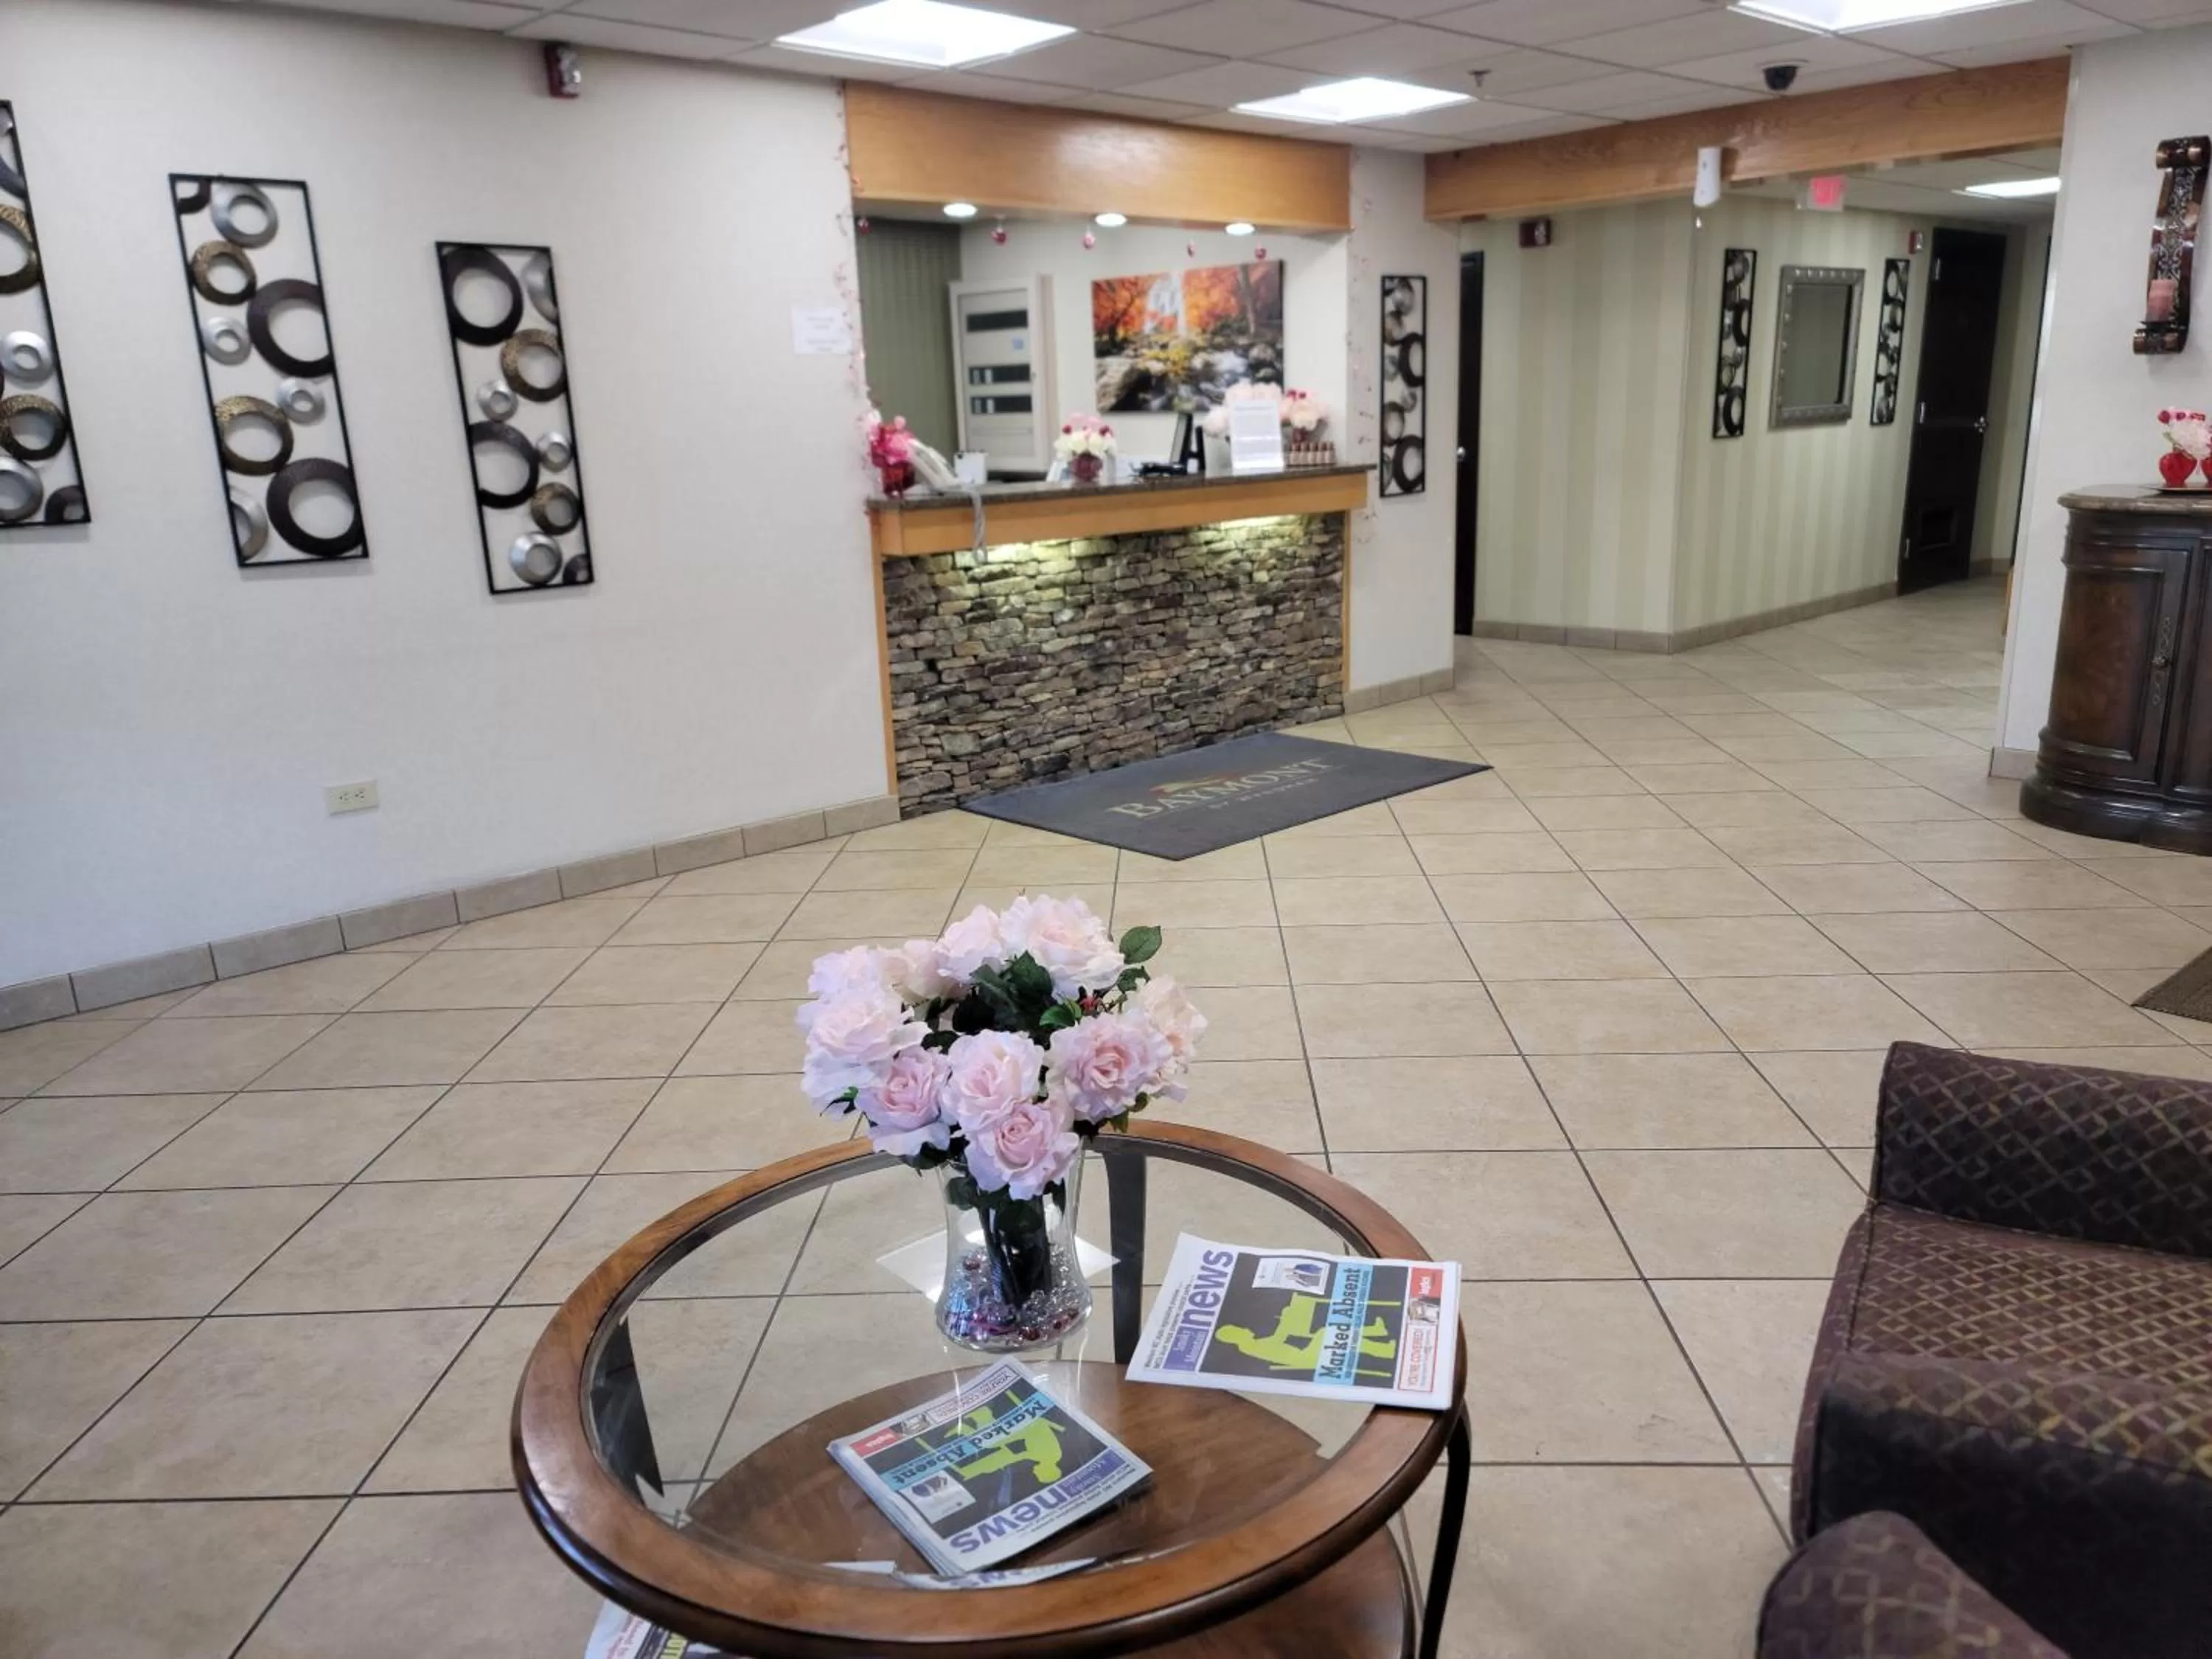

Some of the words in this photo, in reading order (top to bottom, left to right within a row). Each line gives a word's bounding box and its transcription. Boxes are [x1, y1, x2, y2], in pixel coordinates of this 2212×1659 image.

[1108, 757, 1333, 818] BAYMONT
[1181, 1250, 1234, 1326] news
[1332, 1267, 1362, 1319] Absent
[1318, 1322, 1351, 1379] Marked
[970, 1399, 1046, 1447] Marked
[892, 1441, 968, 1484] Absent
[949, 1486, 1068, 1554] news
